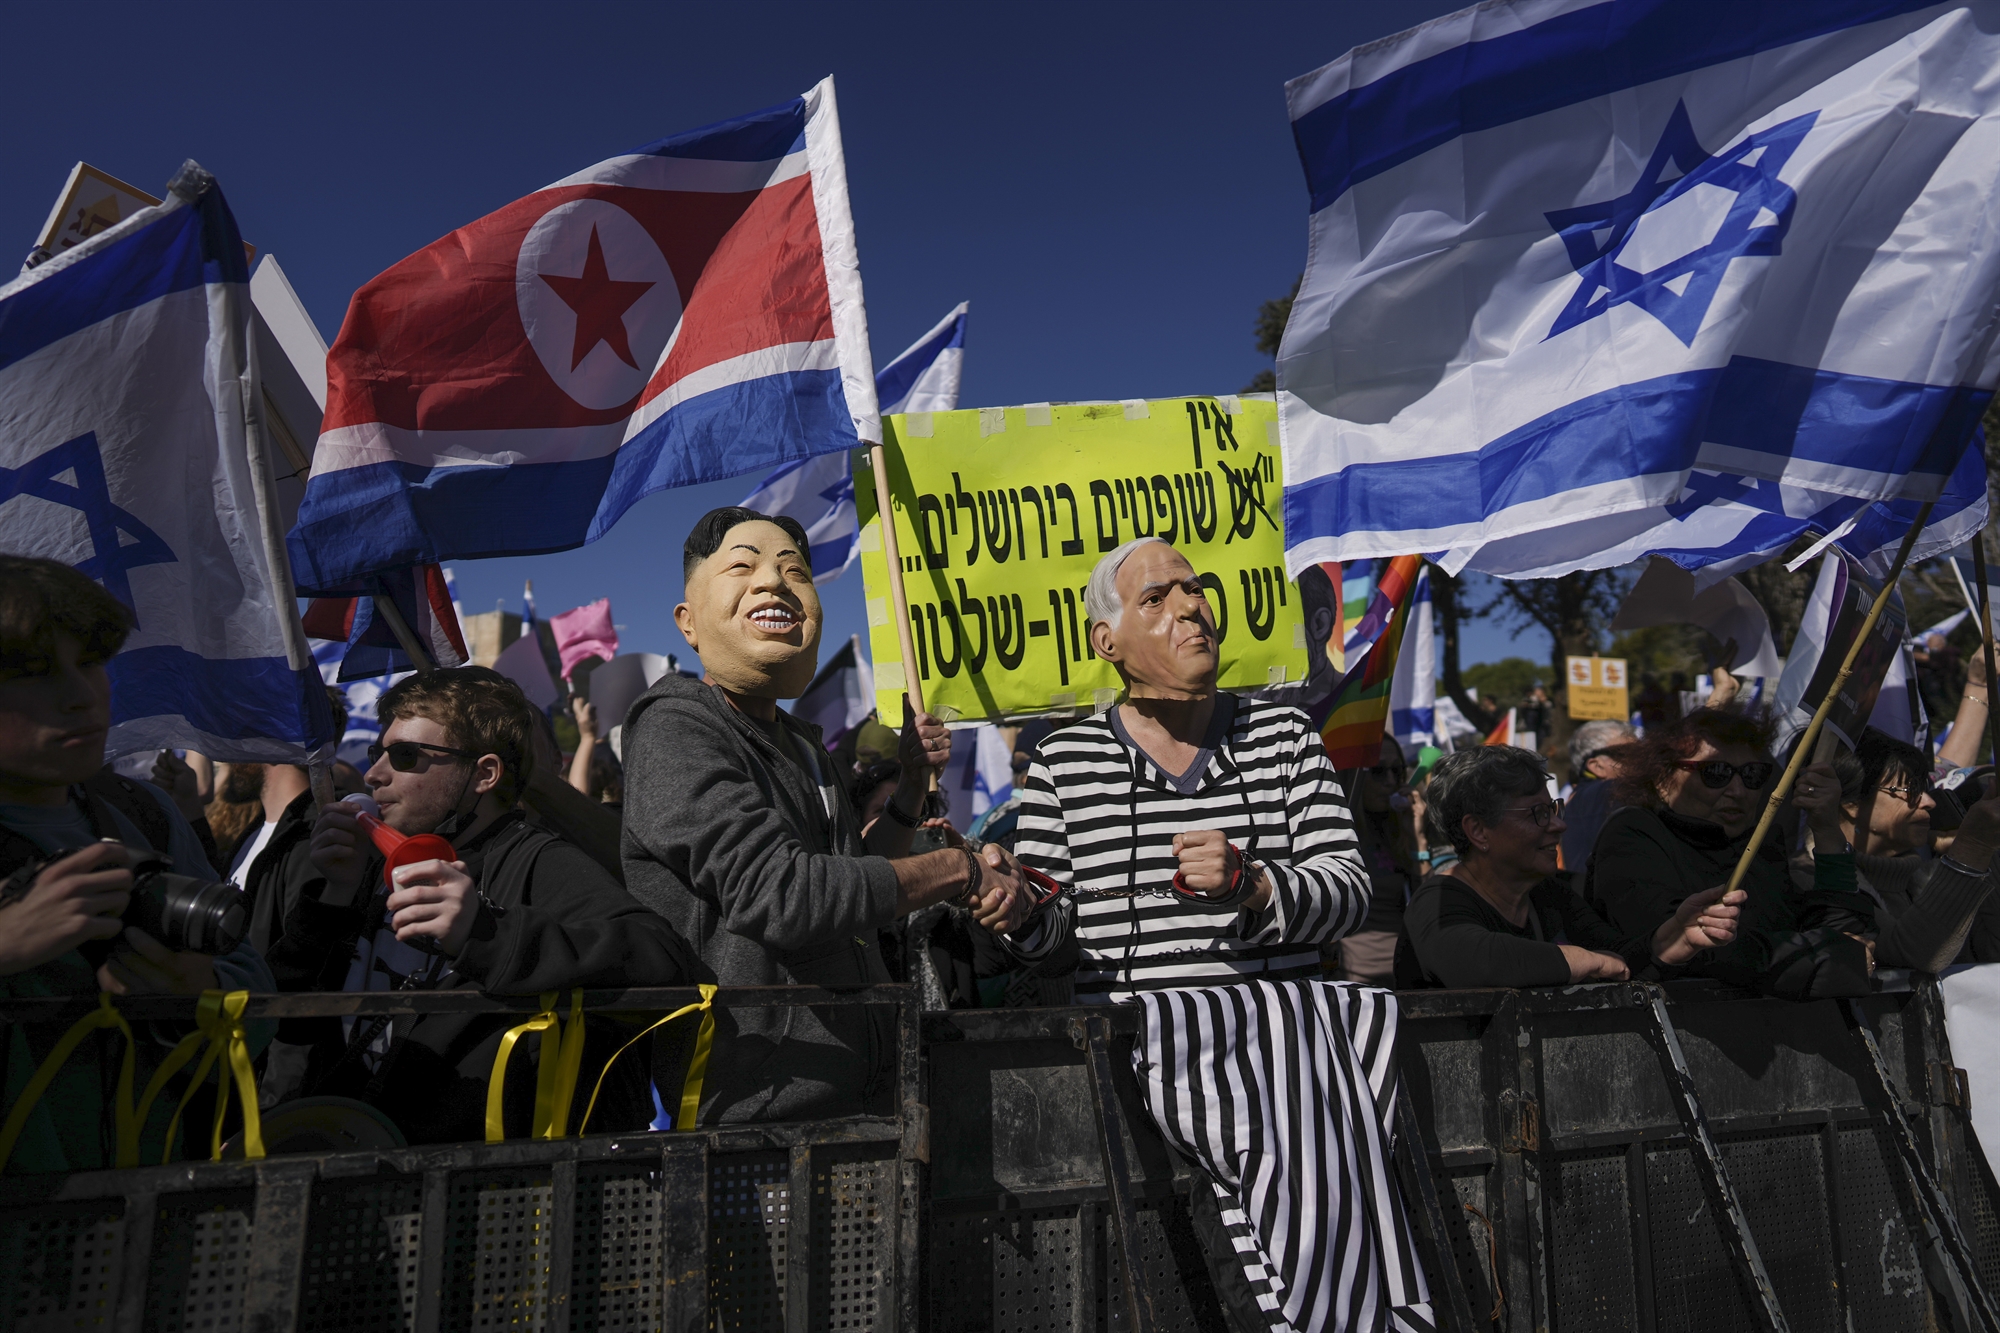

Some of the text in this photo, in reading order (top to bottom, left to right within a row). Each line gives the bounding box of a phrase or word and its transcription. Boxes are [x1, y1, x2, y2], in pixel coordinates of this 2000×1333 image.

[1186, 401, 1239, 470] אין
[1089, 470, 1218, 553] שופטים
[1239, 565, 1287, 642] יש
